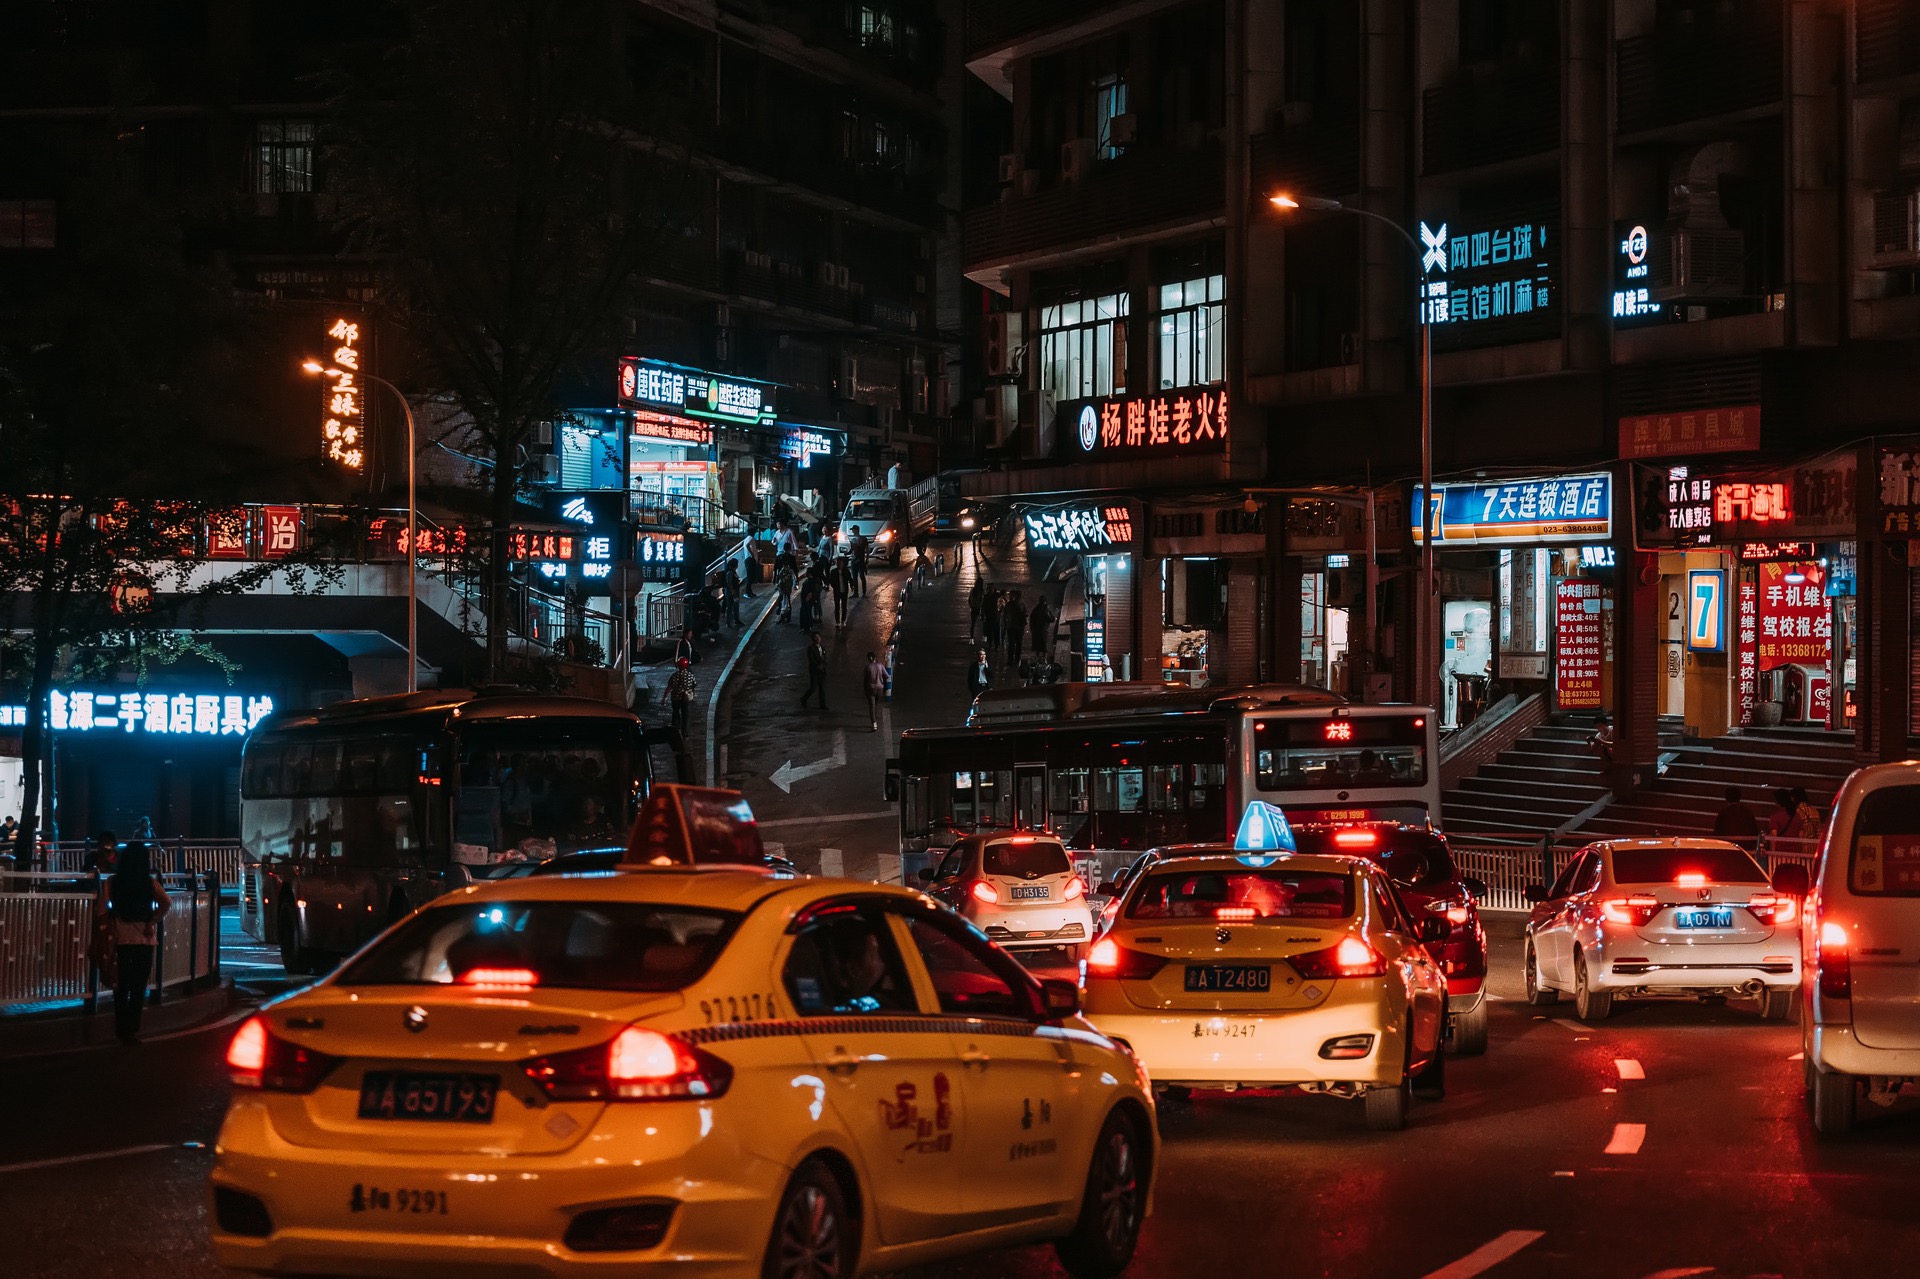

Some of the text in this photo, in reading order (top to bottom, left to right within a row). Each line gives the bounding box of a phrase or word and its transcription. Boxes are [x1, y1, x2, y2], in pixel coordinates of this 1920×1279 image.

[1451, 225, 1532, 270] 网吧台球
[1451, 279, 1533, 322] 宾馆机麻
[637, 367, 684, 405] 唐氏药房
[1481, 480, 1604, 522] 7天连锁酒店
[1669, 480, 1711, 502] 成人用品
[1669, 507, 1711, 529] 无人售卖店
[271, 515, 297, 550] 治
[1542, 525, 1603, 537] 023-63804488
[587, 537, 610, 559] 柜
[1558, 584, 1599, 598] 中兴招待所
[1766, 586, 1826, 607] 手机维
[1669, 592, 1680, 620] 2
[1696, 584, 1714, 638] 7
[1763, 616, 1825, 638] 驾校报名
[1740, 586, 1756, 724] 手机维修 驾校报名点
[1186, 968, 1269, 989] 渝A·T2480
[1223, 1024, 1257, 1038] 9247
